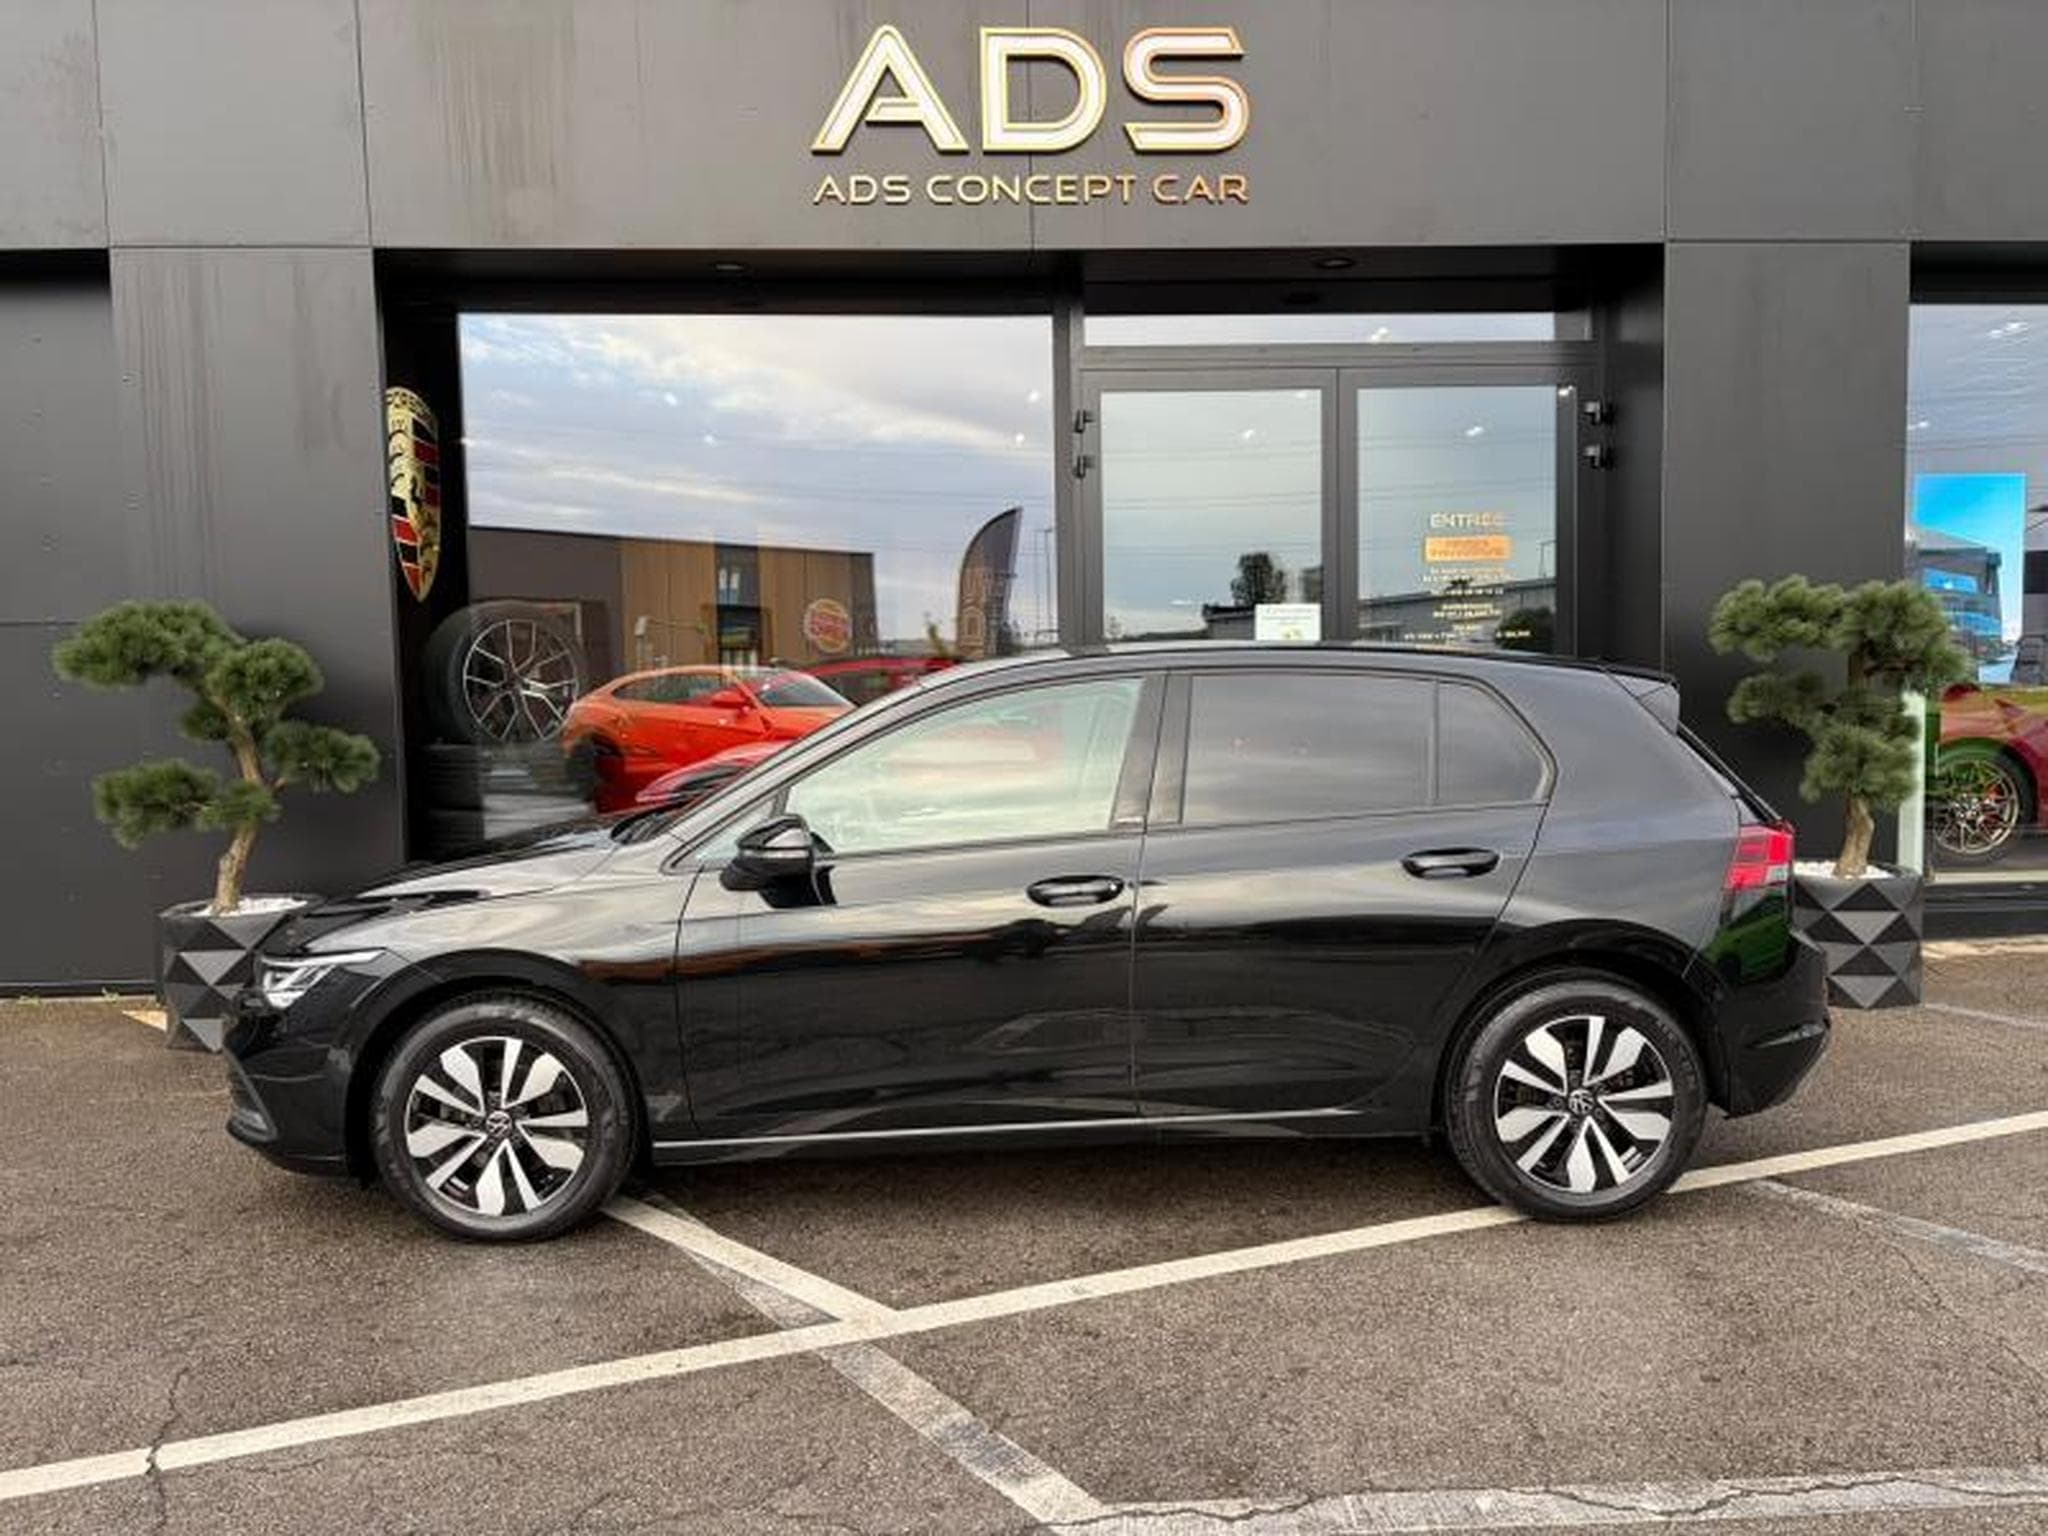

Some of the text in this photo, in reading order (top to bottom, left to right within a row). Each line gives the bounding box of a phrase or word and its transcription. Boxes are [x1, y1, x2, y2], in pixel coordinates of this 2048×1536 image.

[811, 24, 1250, 153] ADS
[813, 174, 1249, 204] ADS CONCEPT CAR
